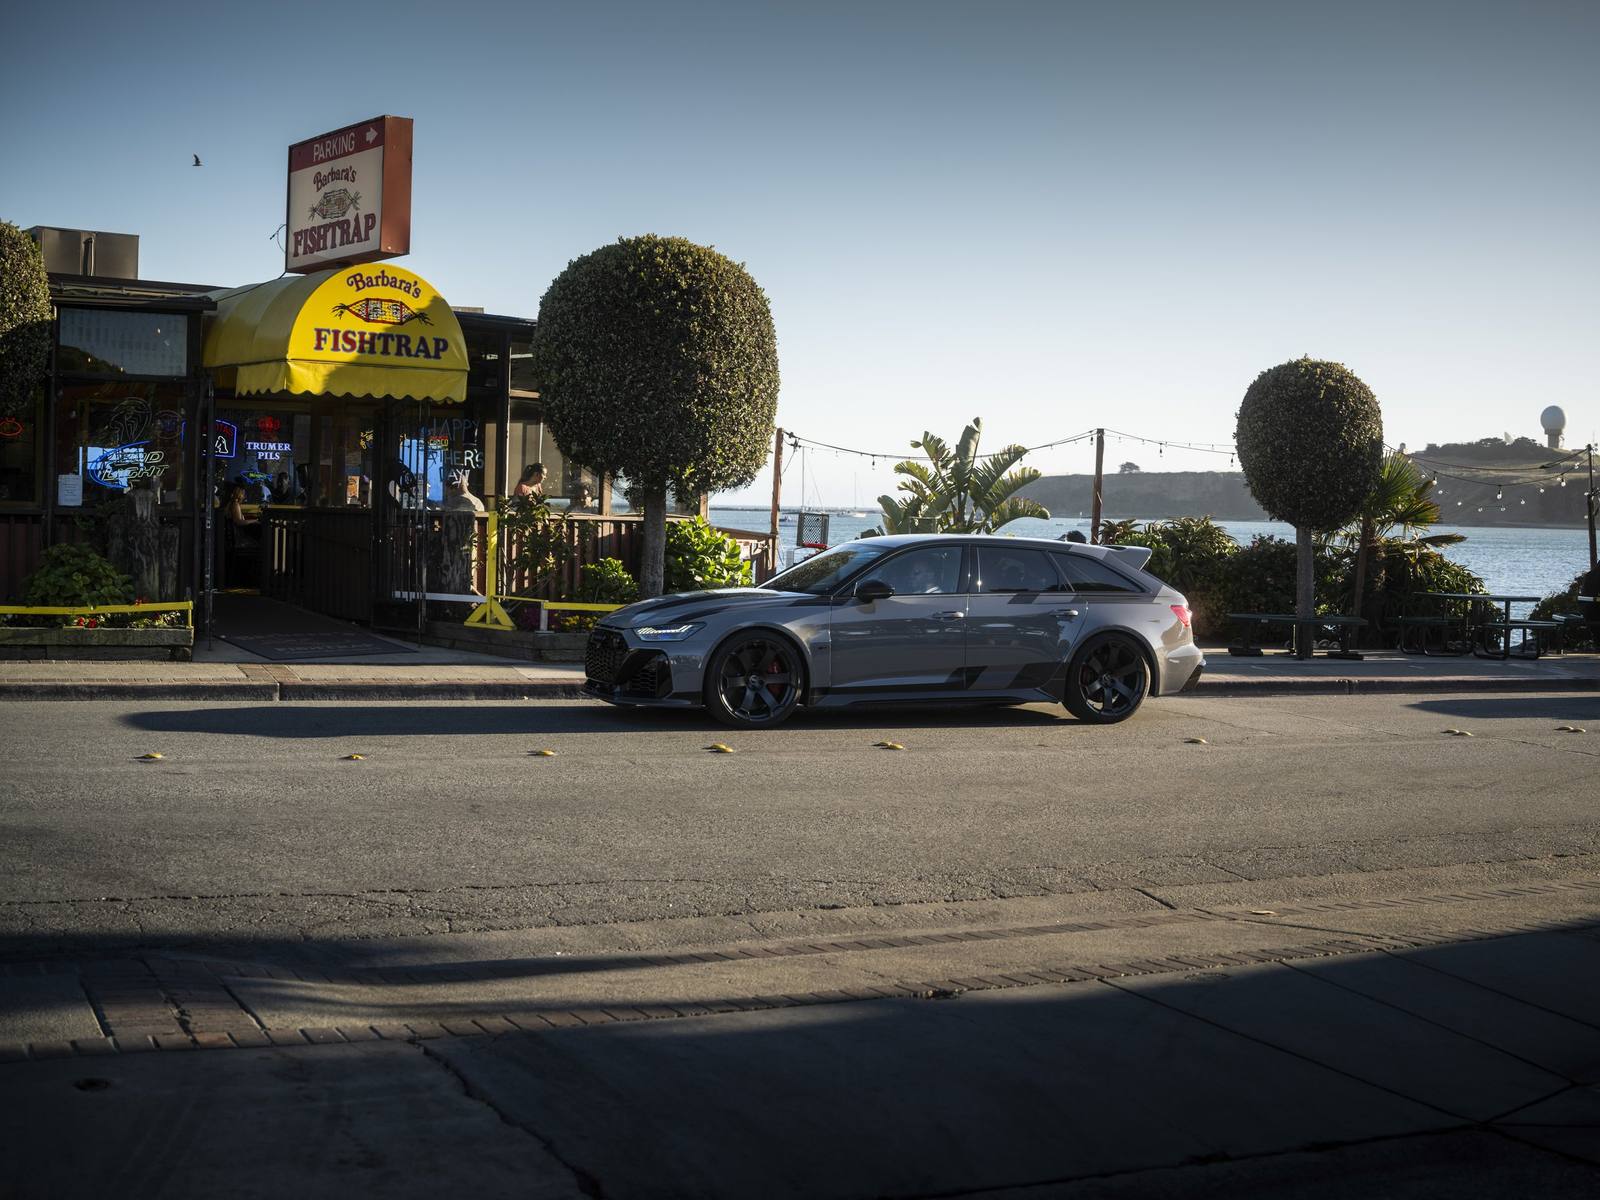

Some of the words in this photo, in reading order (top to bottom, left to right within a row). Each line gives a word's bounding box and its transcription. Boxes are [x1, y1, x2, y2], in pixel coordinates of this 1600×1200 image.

[313, 132, 356, 162] PARKING
[313, 166, 357, 192] Barbara's
[293, 213, 376, 258] FISHTRAP
[346, 270, 422, 299] Barbara's
[313, 327, 449, 360] FISHTRAP
[246, 442, 292, 451] TRUMER
[257, 451, 281, 461] PILS
[102, 465, 169, 481] LGHT
